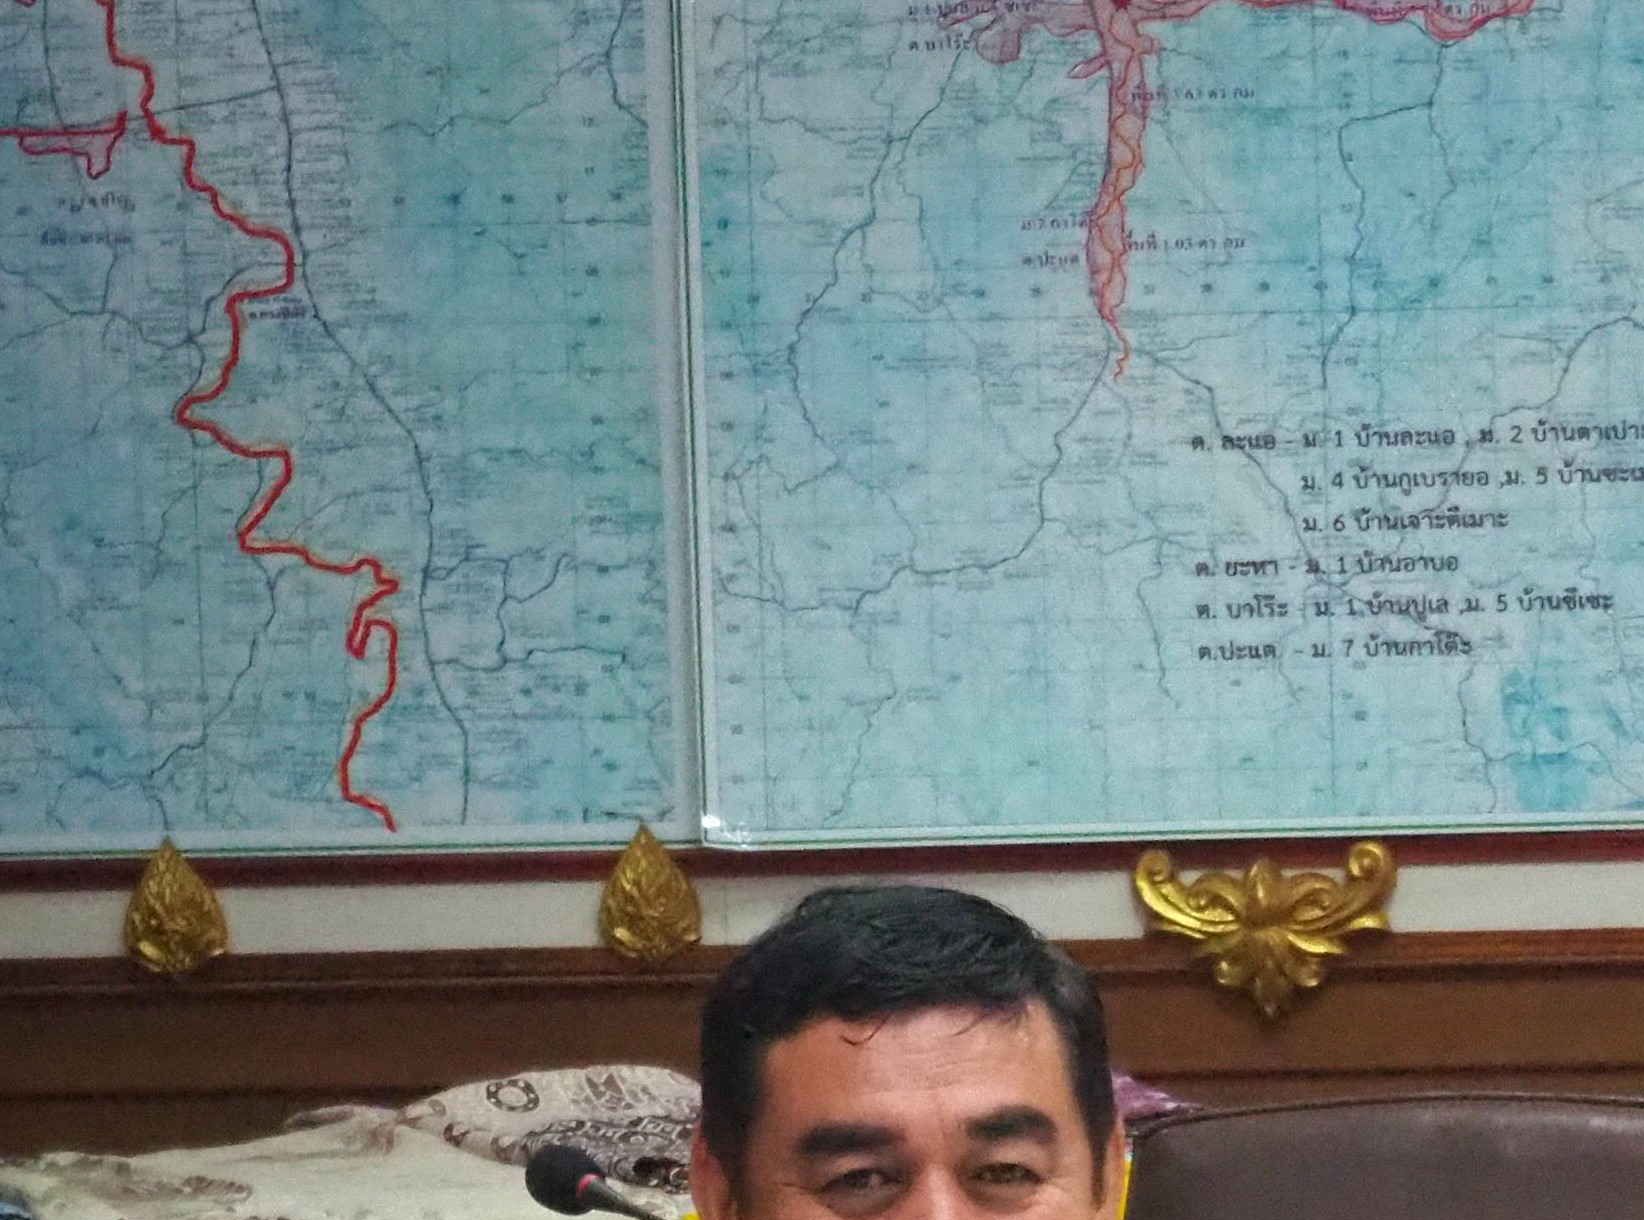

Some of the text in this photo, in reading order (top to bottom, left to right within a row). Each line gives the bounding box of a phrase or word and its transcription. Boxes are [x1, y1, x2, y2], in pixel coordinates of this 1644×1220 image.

[1509, 425, 1523, 443] 2
[1331, 472, 1344, 489] 4
[1535, 466, 1548, 484] 5
[1333, 513, 1346, 532] 6
[1496, 594, 1508, 612] 5
[1342, 640, 1354, 657] 7
